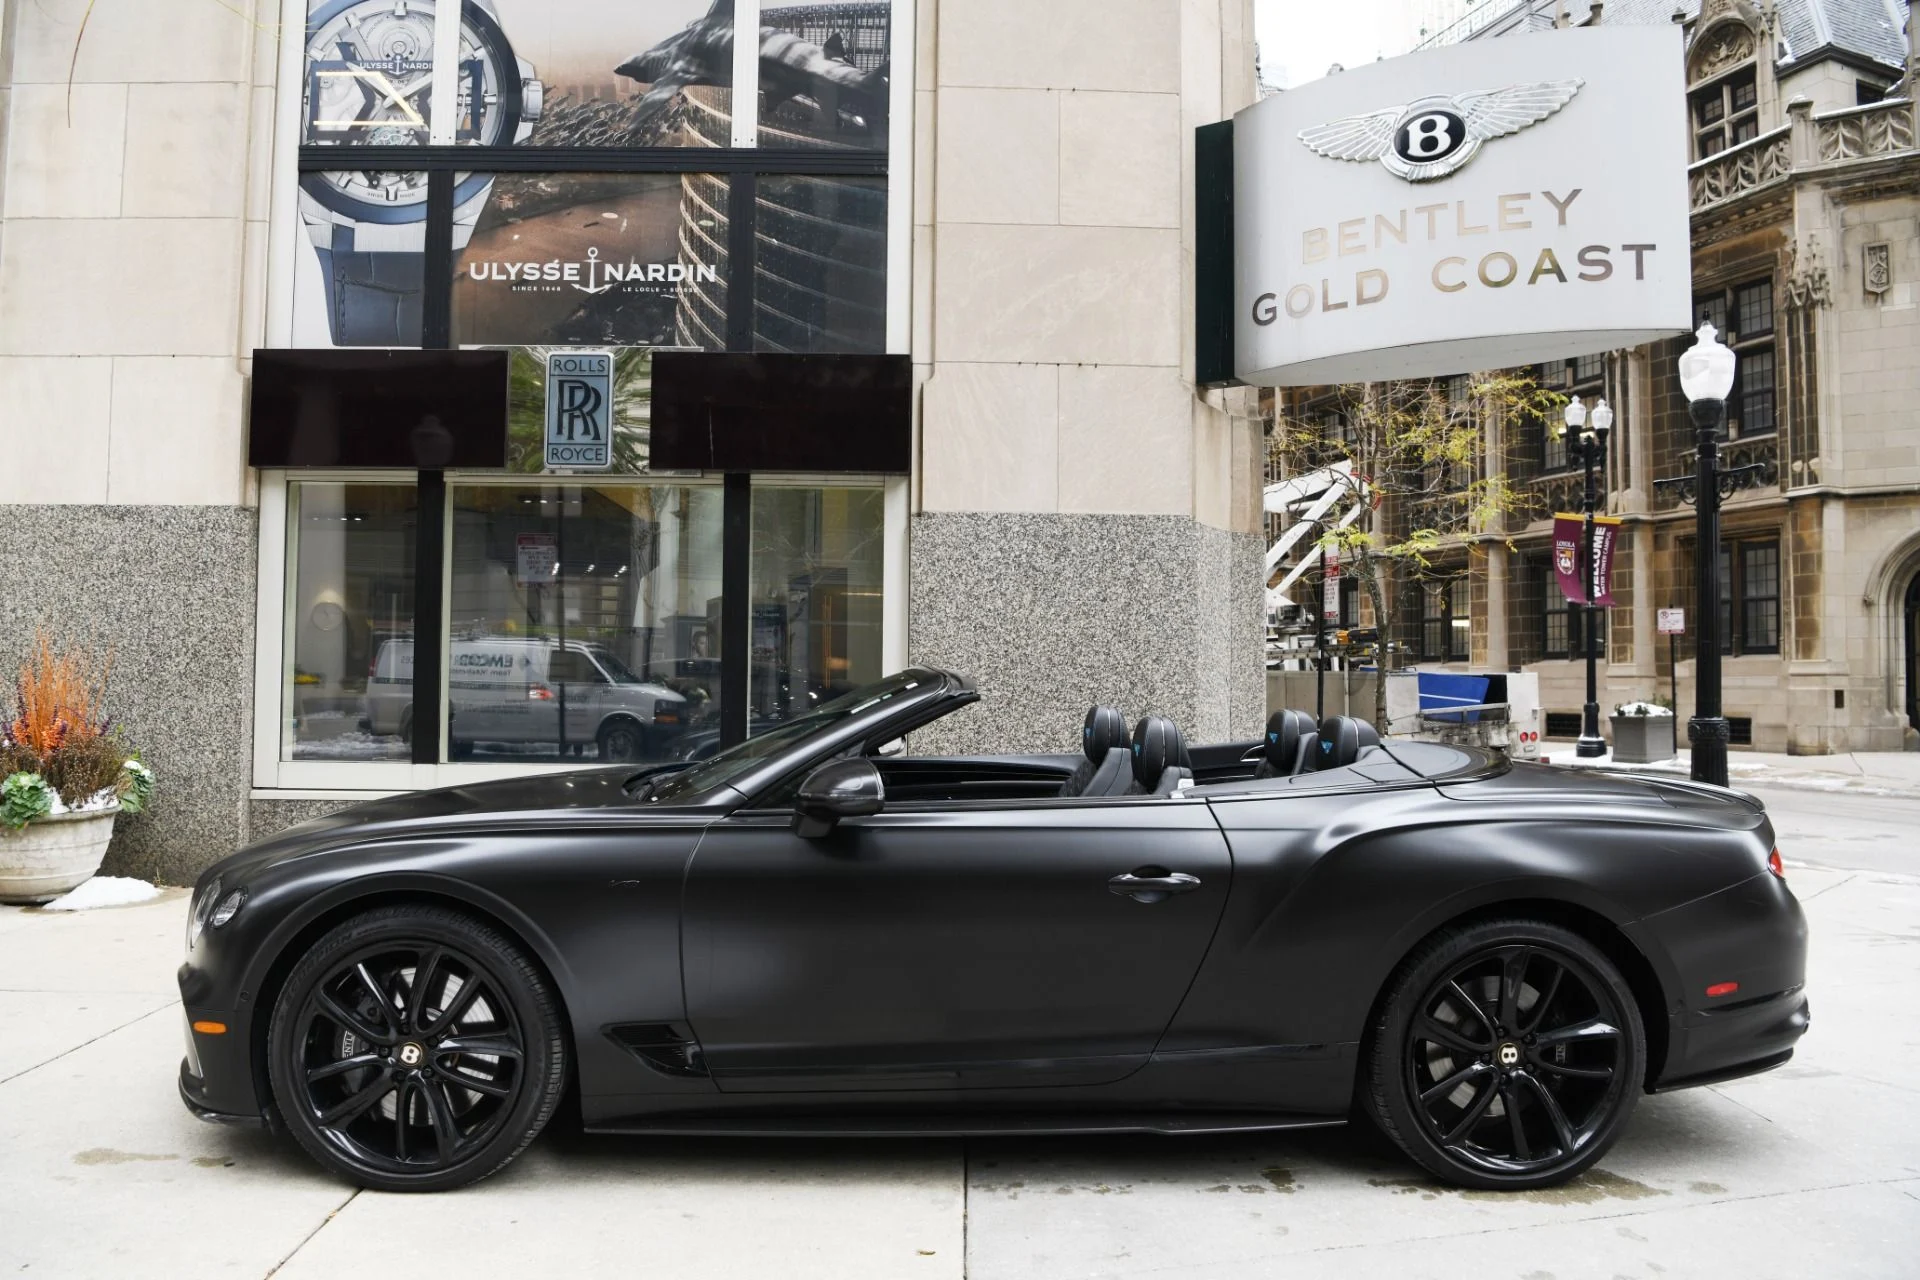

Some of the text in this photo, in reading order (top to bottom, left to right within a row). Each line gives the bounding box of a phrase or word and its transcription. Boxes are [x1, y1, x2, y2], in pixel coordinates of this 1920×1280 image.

[1302, 188, 1582, 265] BENTLEY
[469, 262, 716, 282] ULYSSE NARDIN
[1251, 243, 1656, 326] GOLD COAST
[553, 359, 606, 373] ROLLS
[551, 447, 604, 461] ROYCE
[1592, 526, 1606, 598] WELCOME
